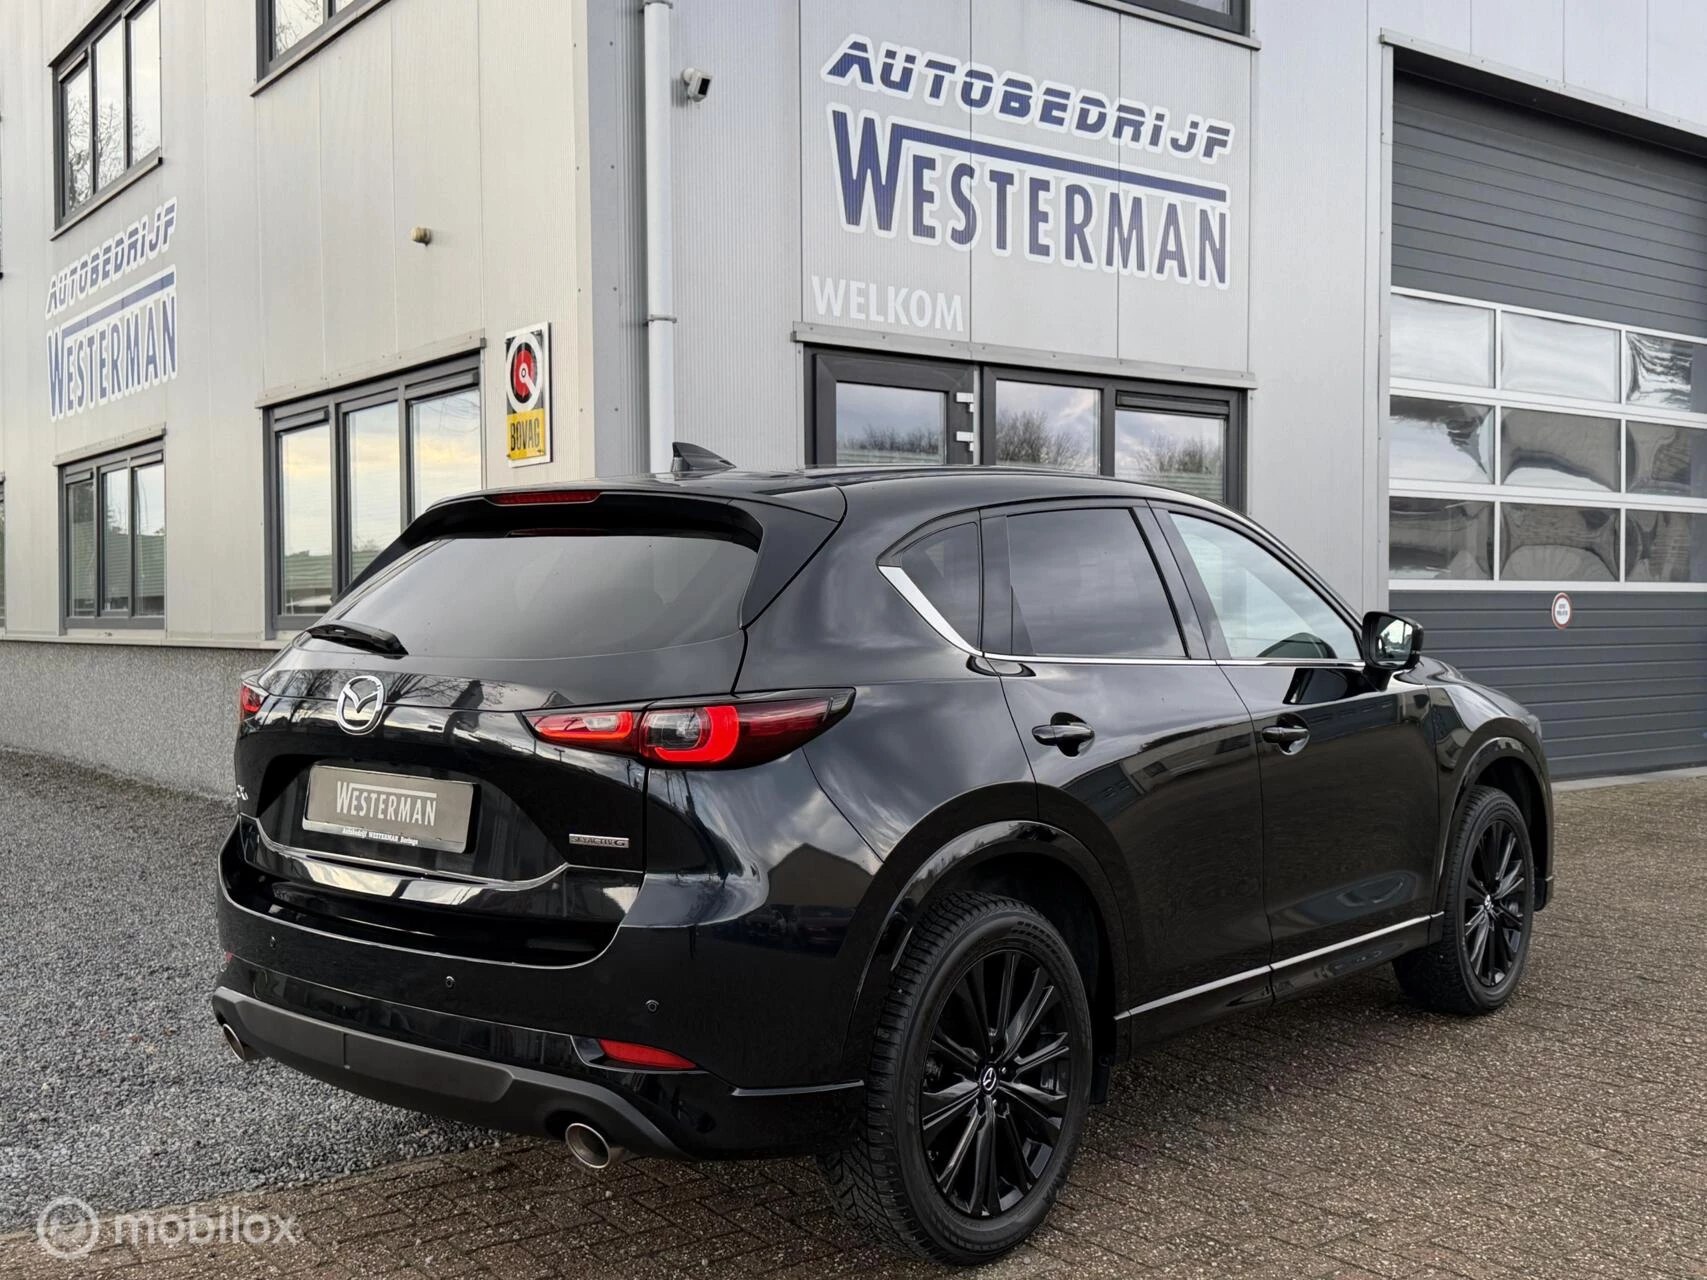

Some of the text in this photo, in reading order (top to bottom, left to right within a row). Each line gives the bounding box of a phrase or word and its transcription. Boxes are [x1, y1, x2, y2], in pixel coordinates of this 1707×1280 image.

[825, 39, 1231, 160] AUTOBEDRIJF
[831, 108, 1227, 285] WESTERMAN
[45, 202, 176, 315] AUTOBEDRIJF
[811, 275, 964, 332] WELKOM
[47, 275, 176, 417] WESTERMAN
[510, 417, 541, 451] BOVAG
[336, 780, 437, 827] WESTERMAN
